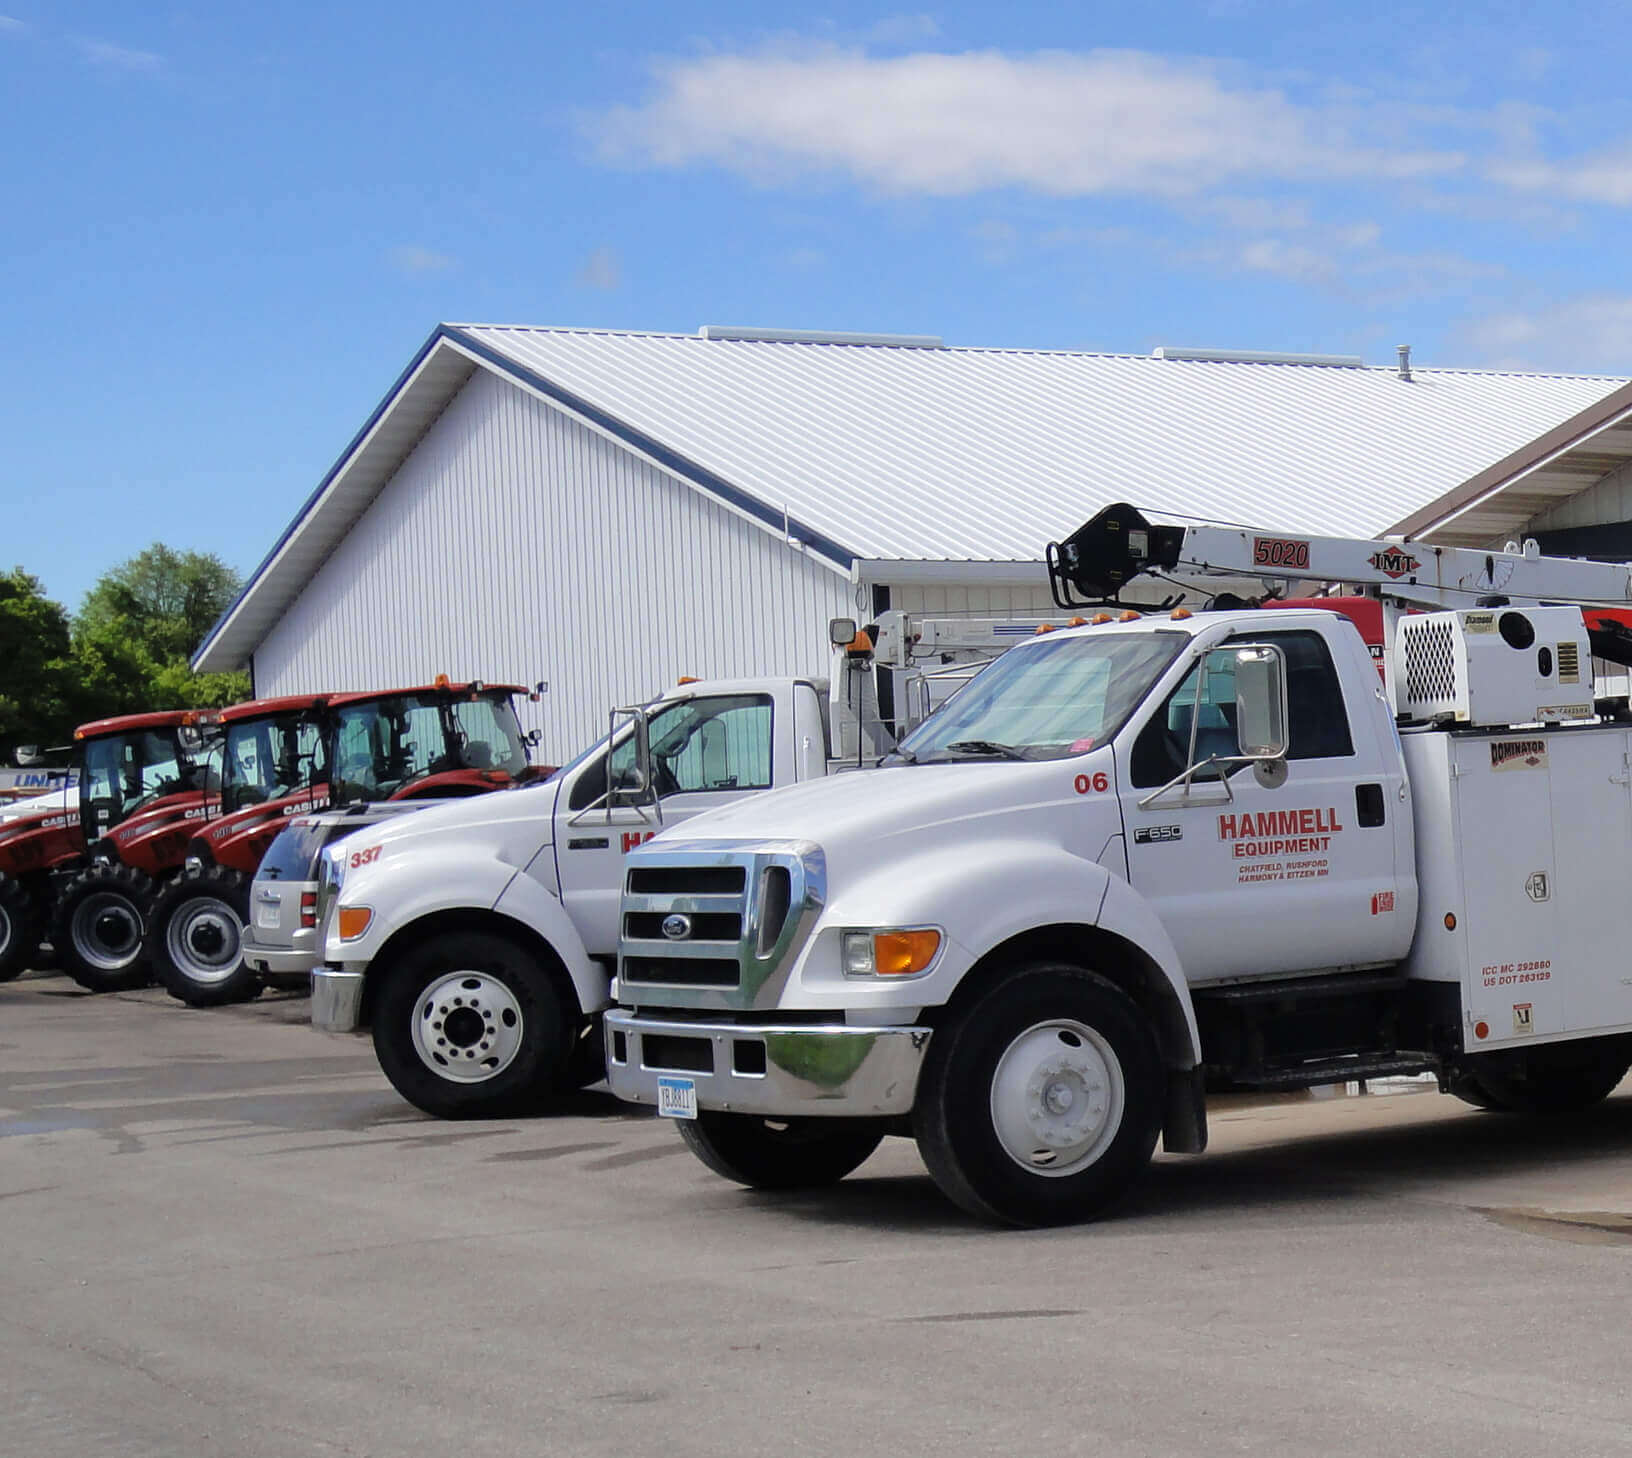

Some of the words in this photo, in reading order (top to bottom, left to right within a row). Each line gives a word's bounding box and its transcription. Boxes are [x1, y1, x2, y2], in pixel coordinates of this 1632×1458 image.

[1256, 540, 1308, 567] 5020
[1374, 553, 1415, 573] IMT
[1490, 740, 1546, 766] DOMINATOR
[1074, 772, 1108, 794] 06
[1219, 808, 1343, 840] HAMMELL
[350, 846, 383, 868] 337
[1234, 837, 1331, 857] EQUIPMENT
[1286, 860, 1328, 870] RUSHFORD
[1238, 872, 1277, 883] HARMONY
[1286, 869, 1315, 880] EITZEN
[1317, 868, 1329, 877] MN
[1482, 966, 1498, 976] ICC
[1500, 964, 1514, 974] MC
[1484, 977, 1497, 987] US
[1498, 975, 1517, 985] DOT
